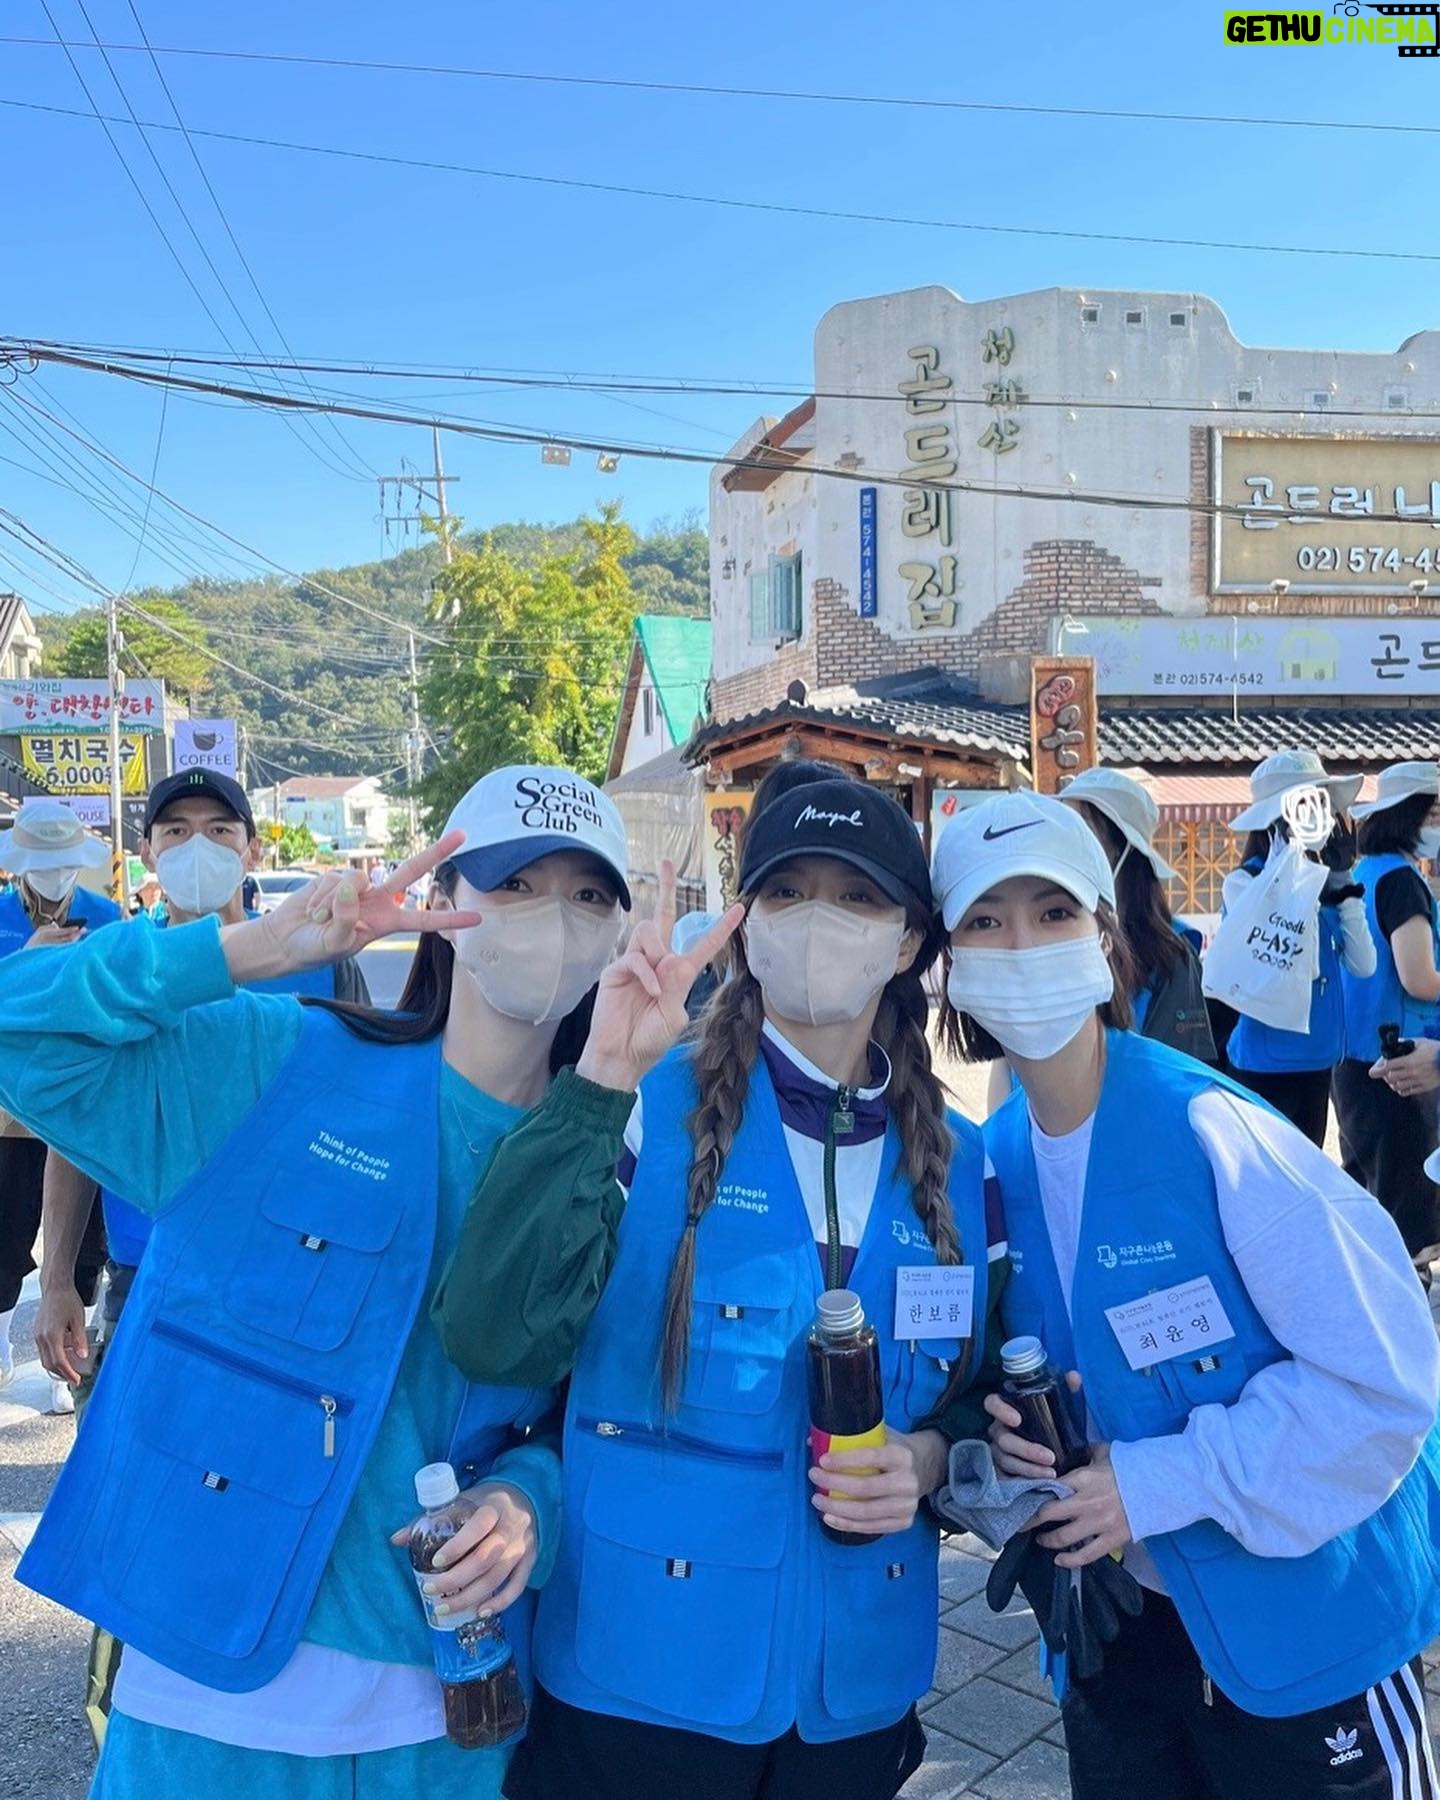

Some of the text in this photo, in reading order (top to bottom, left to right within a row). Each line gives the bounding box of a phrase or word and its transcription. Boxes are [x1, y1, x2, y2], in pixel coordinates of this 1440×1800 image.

[898, 346, 957, 631] 곤드레집
[30, 738, 136, 764] 멸치국수
[179, 754, 232, 766] COFFEE
[514, 776, 597, 809] Social
[76, 810, 105, 821] OUSE
[521, 806, 578, 833] Club
[541, 795, 603, 828] Green
[308, 1141, 387, 1181] Hope for Change
[319, 1130, 390, 1169] Think of People
[722, 1185, 734, 1194] of
[735, 1185, 768, 1199] People
[733, 1198, 769, 1214] Change
[1329, 1748, 1364, 1766] adidas
